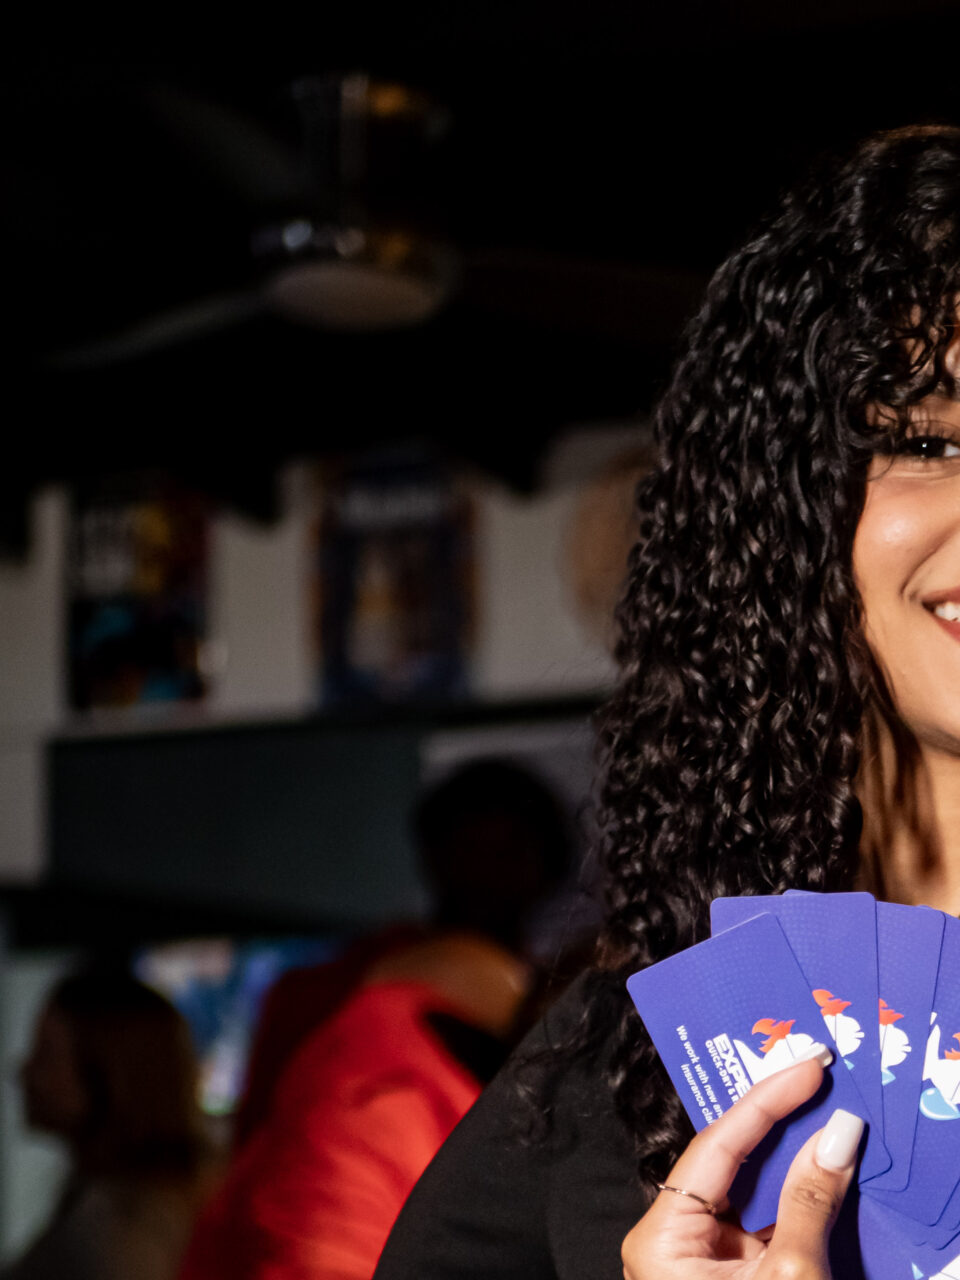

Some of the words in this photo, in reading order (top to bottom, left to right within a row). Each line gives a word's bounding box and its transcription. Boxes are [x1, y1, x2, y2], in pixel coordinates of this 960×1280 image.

[676, 1025, 688, 1041] We
[683, 1041, 700, 1064] work
[694, 1064, 709, 1084] with
[704, 1084, 718, 1103] new
[705, 1040, 732, 1087] QUICK-DRY
